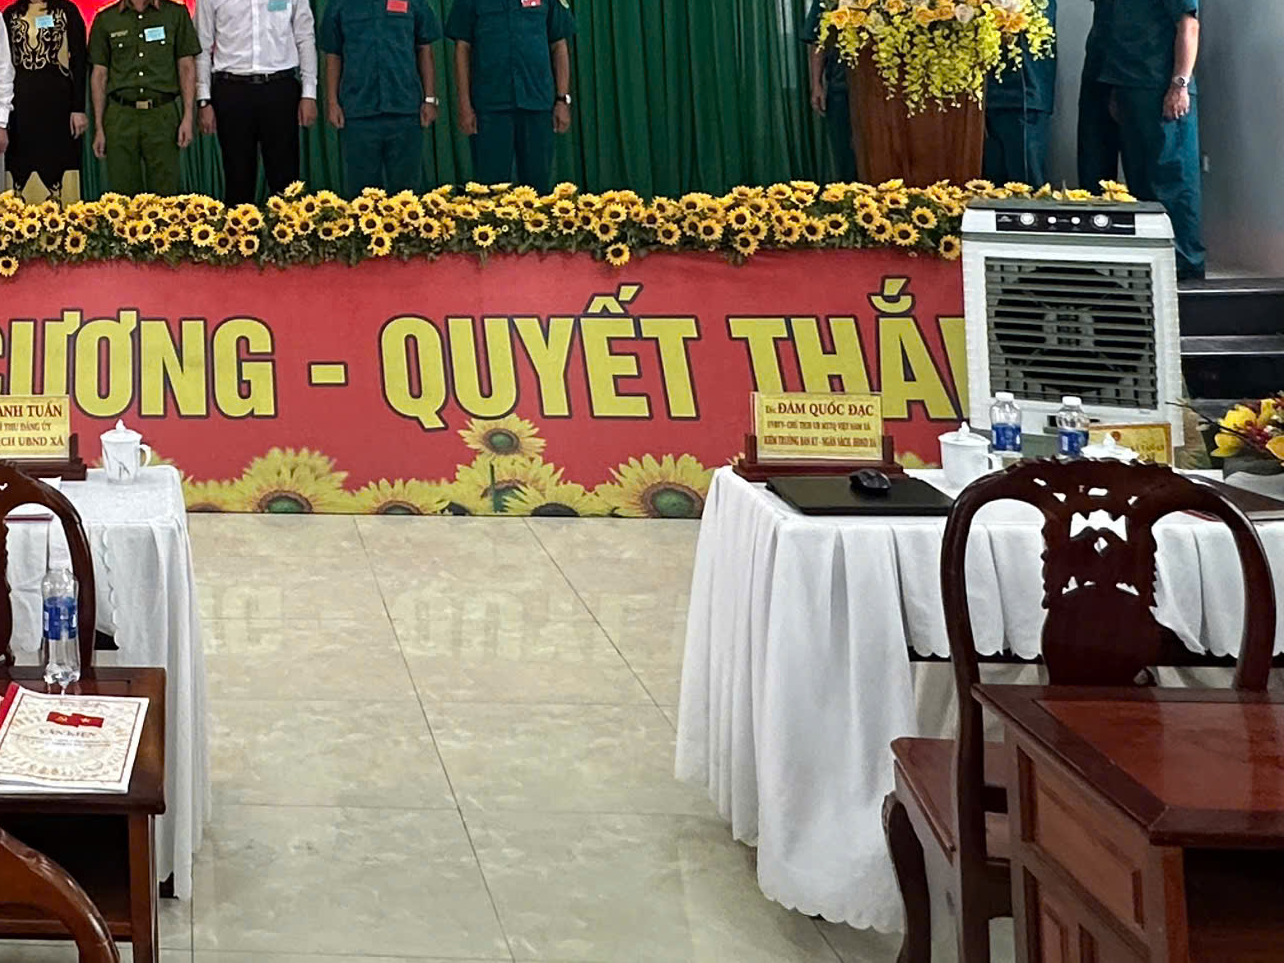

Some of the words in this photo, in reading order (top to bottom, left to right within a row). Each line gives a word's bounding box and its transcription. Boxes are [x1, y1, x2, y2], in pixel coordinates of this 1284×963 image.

[308, 363, 348, 385] -
[378, 283, 702, 432] QUYẾT
[27, 401, 62, 417] TUẤN
[809, 401, 844, 417] QUỐC
[848, 404, 874, 417] ĐẠC
[18, 437, 47, 446] UBND
